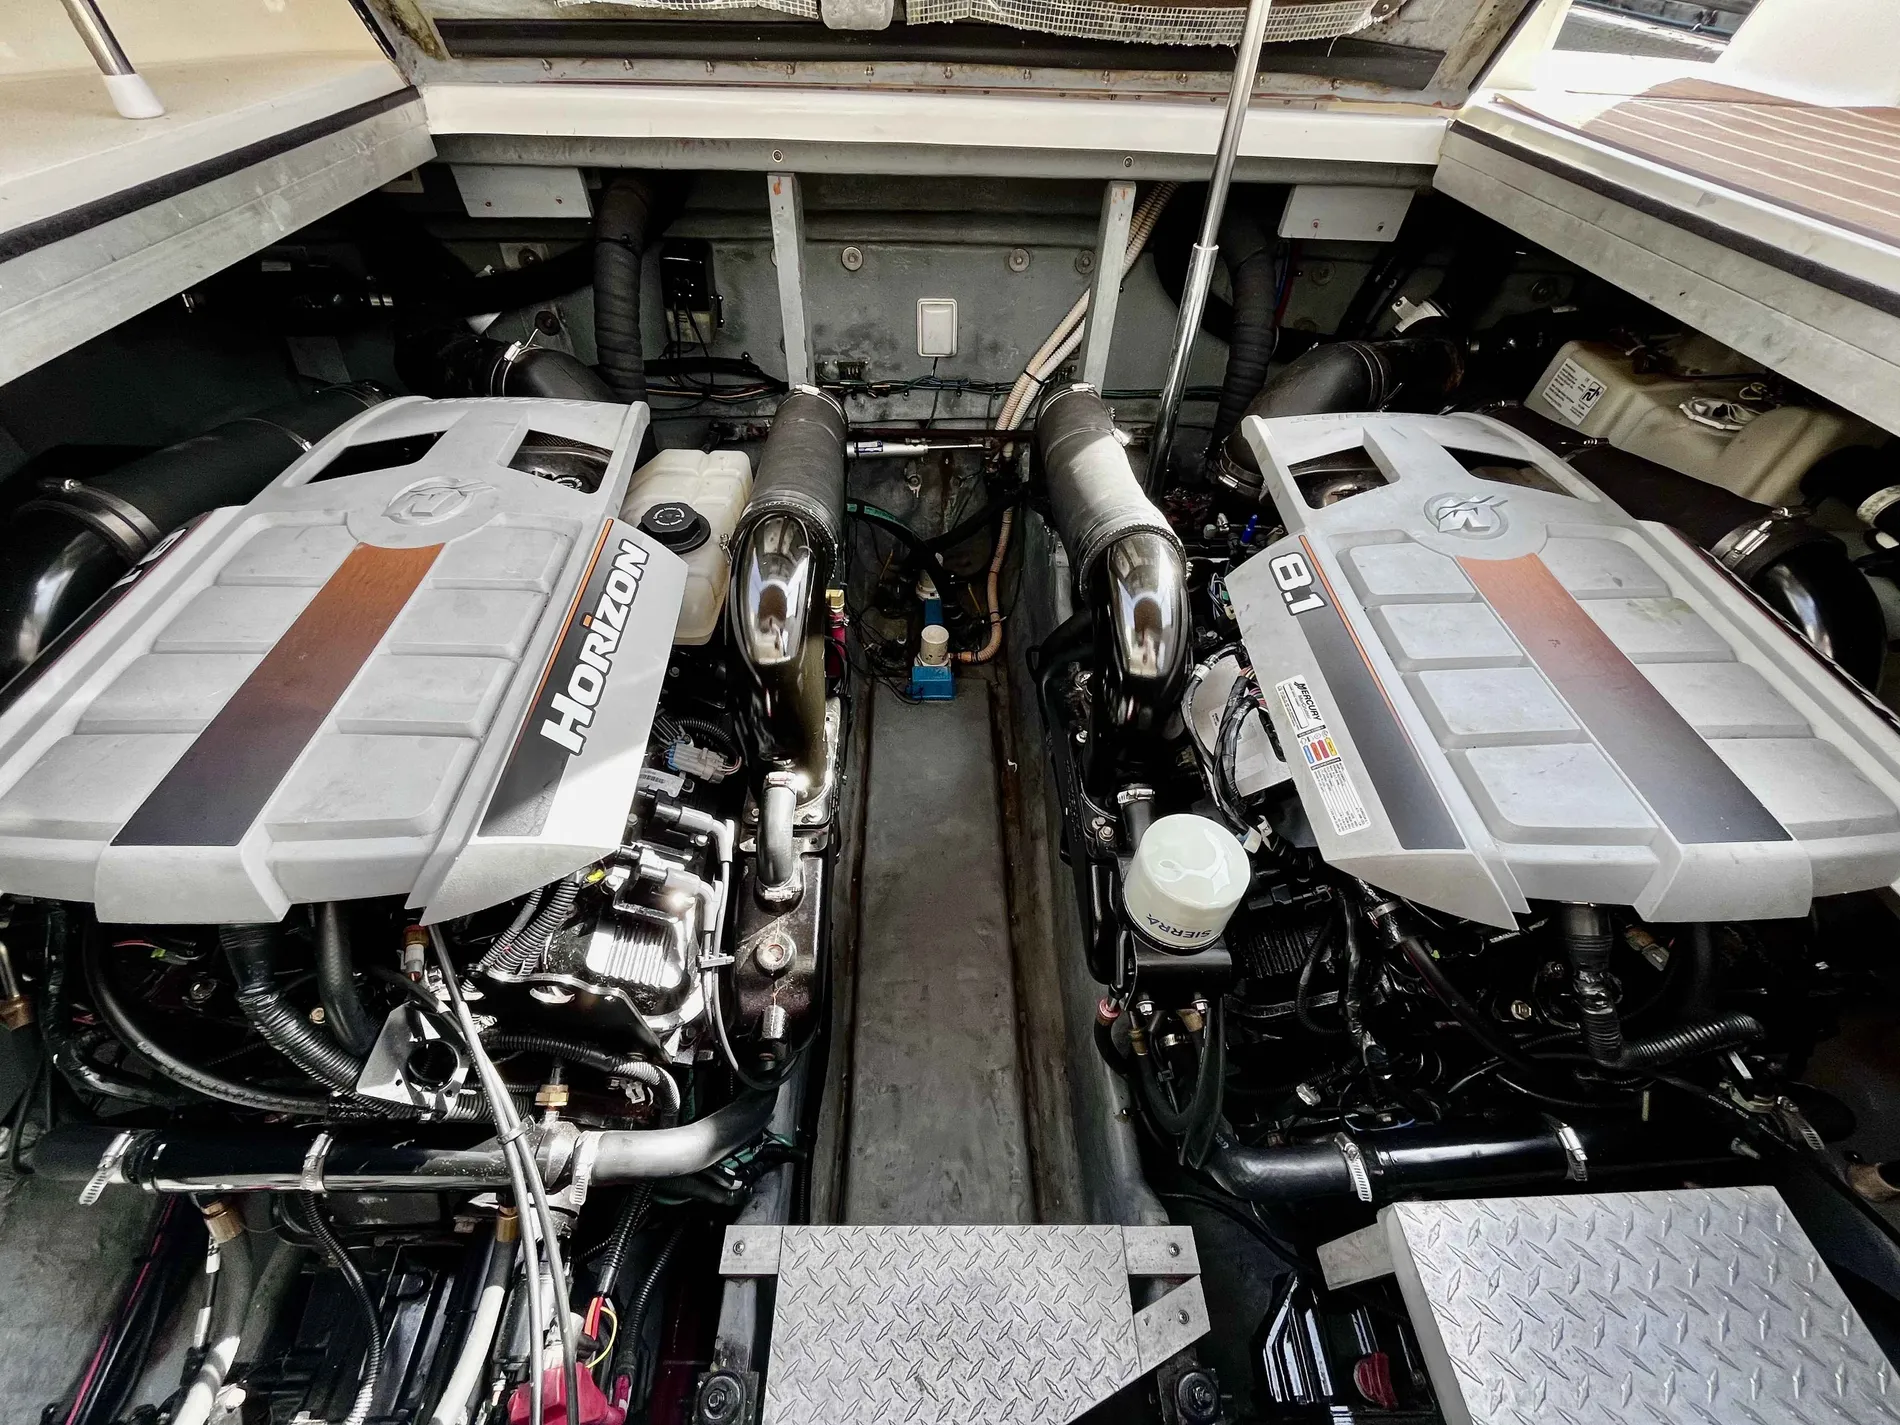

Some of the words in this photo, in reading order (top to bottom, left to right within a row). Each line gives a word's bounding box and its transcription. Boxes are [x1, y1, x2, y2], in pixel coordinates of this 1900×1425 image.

[1270, 552, 1327, 615] 8.1
[1294, 681, 1322, 721] MERCURY
[1146, 913, 1212, 939] SIERRA
